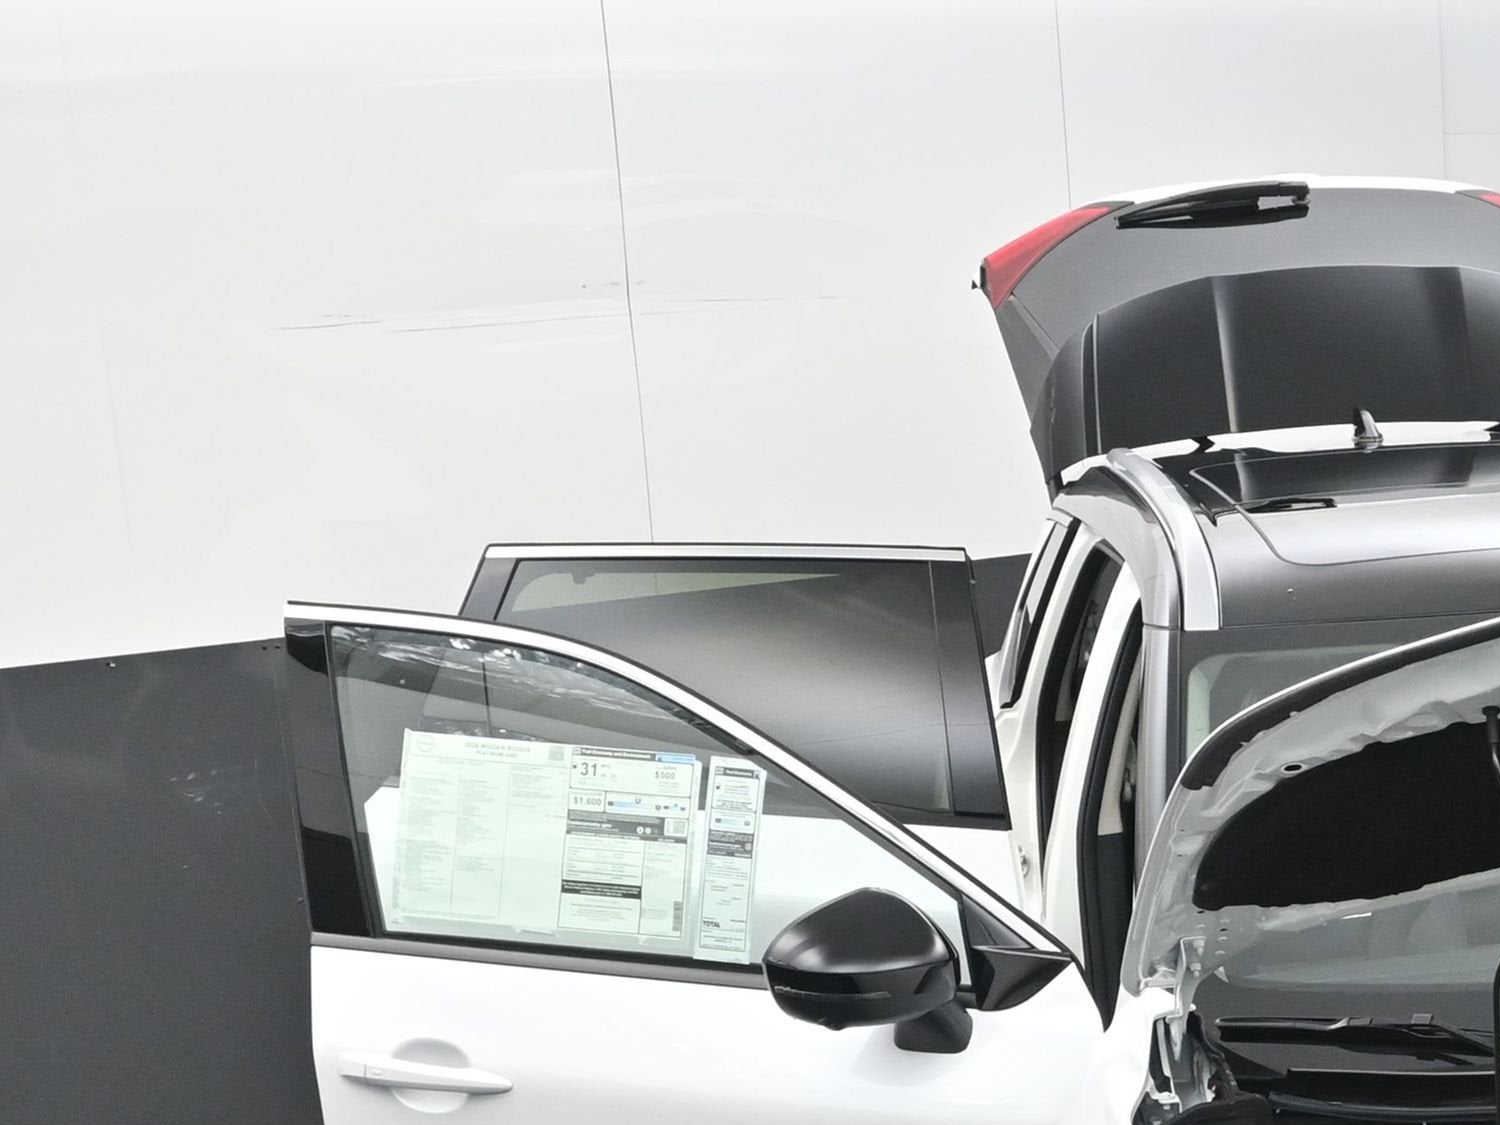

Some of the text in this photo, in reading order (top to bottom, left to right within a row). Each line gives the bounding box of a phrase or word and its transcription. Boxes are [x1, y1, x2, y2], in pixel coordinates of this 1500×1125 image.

[580, 761, 598, 776] 31
[655, 770, 676, 780] $500
[573, 796, 602, 806] $1,600
[702, 920, 721, 928] TOTAL
